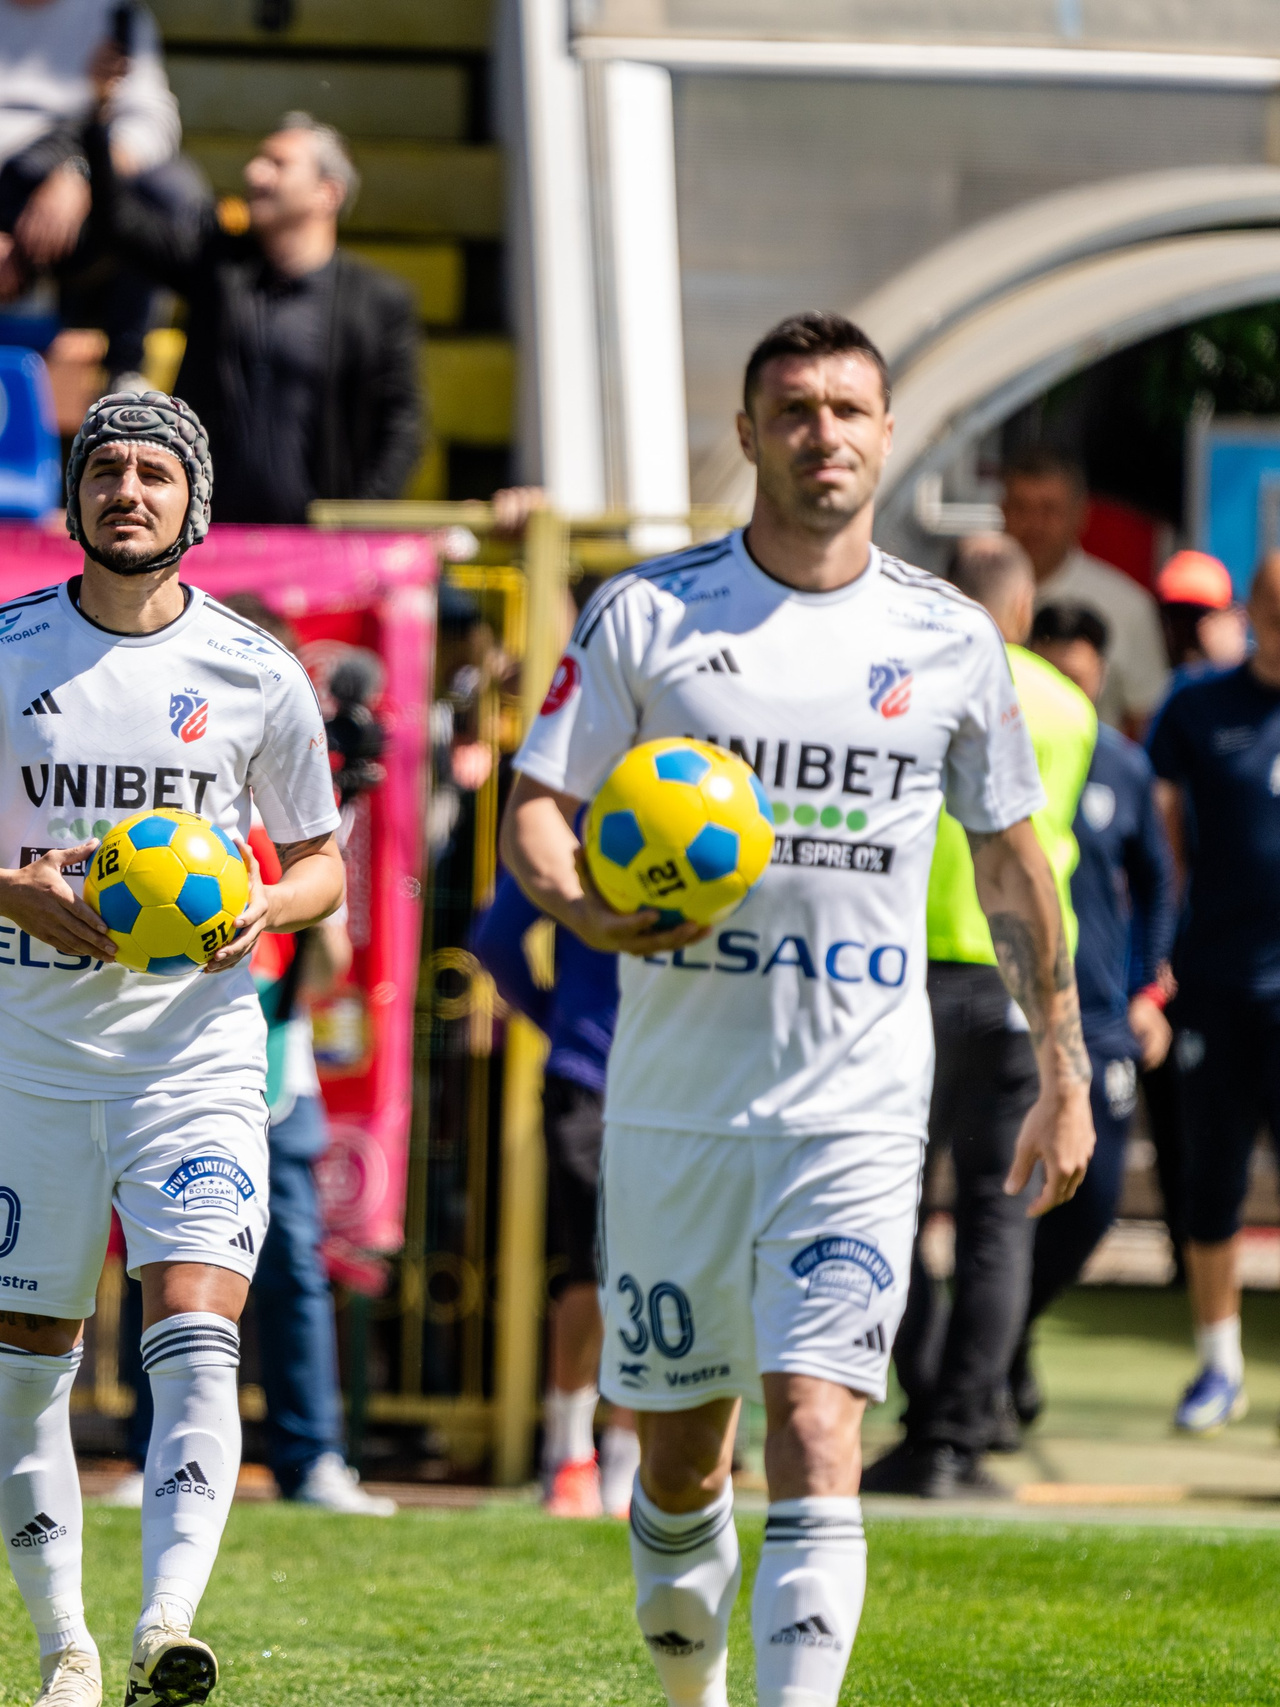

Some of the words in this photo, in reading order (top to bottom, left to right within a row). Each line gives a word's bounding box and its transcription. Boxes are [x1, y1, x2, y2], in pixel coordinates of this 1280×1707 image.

[684, 733, 918, 801] NIBET
[21, 763, 218, 815] UNIBET
[97, 848, 119, 881] 12
[799, 841, 853, 868] SPRE
[648, 860, 687, 897] 12
[201, 921, 229, 952] 12
[643, 929, 908, 988] LSACO
[166, 1171, 189, 1194] FIVE
[188, 1160, 253, 1195] CONTINENTS
[189, 1187, 234, 1195] BOTOSANI
[618, 1273, 696, 1359] 30
[664, 1363, 731, 1388] Vestra
[154, 1479, 216, 1501] adidas
[10, 1523, 68, 1548] adidas
